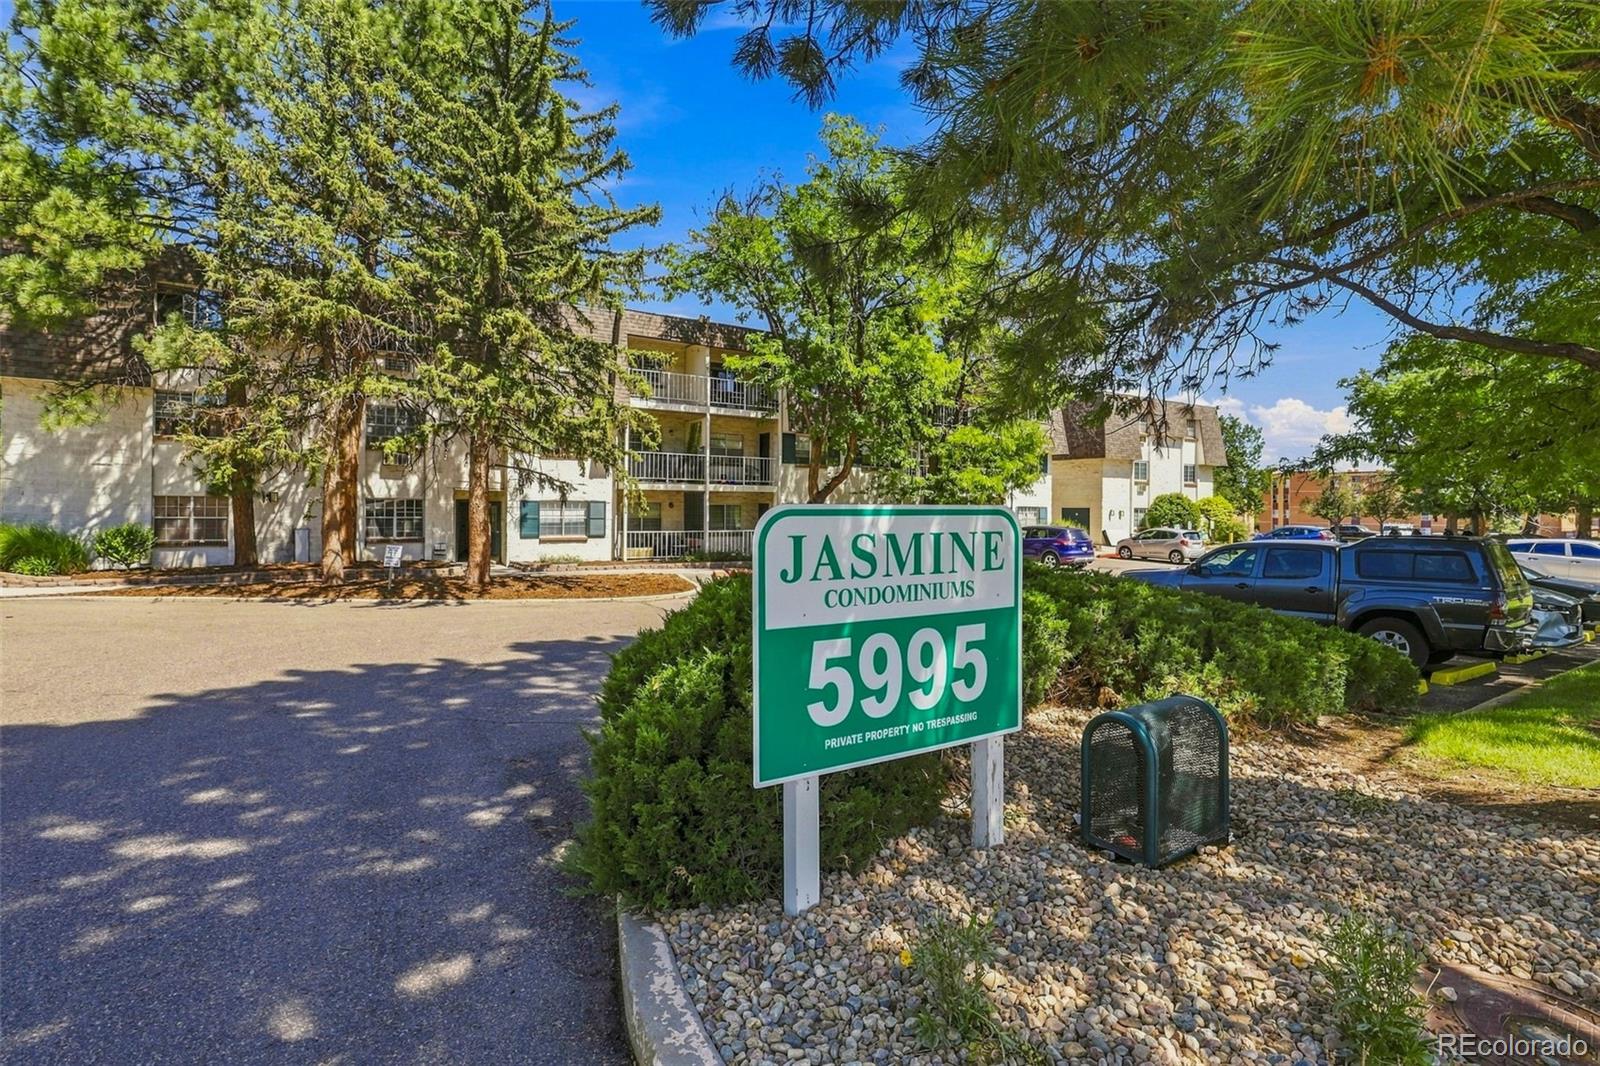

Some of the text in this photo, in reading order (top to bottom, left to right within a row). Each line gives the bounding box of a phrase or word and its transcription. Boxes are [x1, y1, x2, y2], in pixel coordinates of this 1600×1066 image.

[779, 531, 1005, 583] JASMINE
[824, 580, 975, 608] CONDOMINIUMS
[806, 622, 988, 727] 5995
[824, 711, 978, 750] PRIVATE PROPERTY NO TRESPASSING
